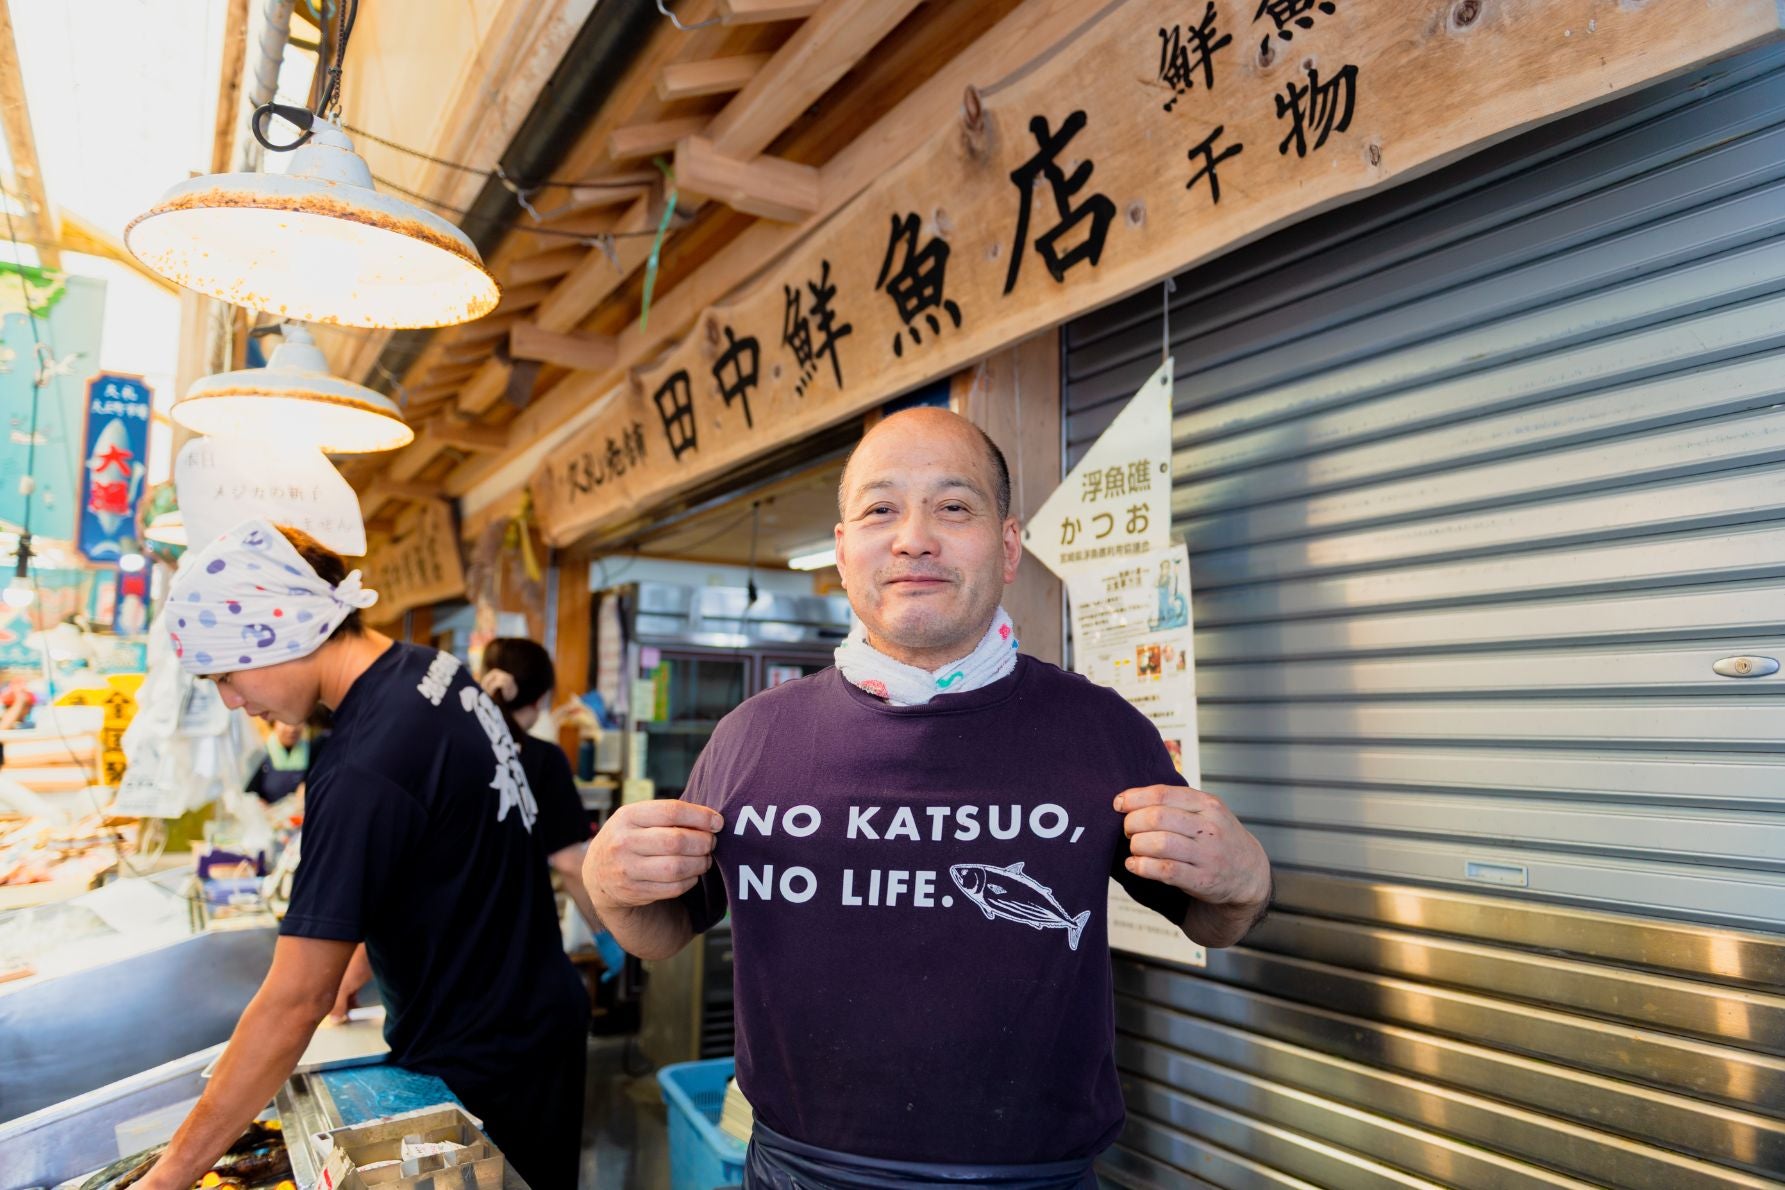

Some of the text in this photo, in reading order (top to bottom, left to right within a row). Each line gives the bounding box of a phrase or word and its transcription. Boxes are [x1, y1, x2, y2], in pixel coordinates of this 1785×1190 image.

[1186, 65, 1359, 204] 干物
[654, 110, 1116, 462] 田中鮮魚店
[1081, 459, 1151, 503] 浮魚礁
[1060, 503, 1150, 546] かつお
[734, 803, 1085, 843] NO KATSUO,
[738, 864, 955, 908] NO LIFE.
